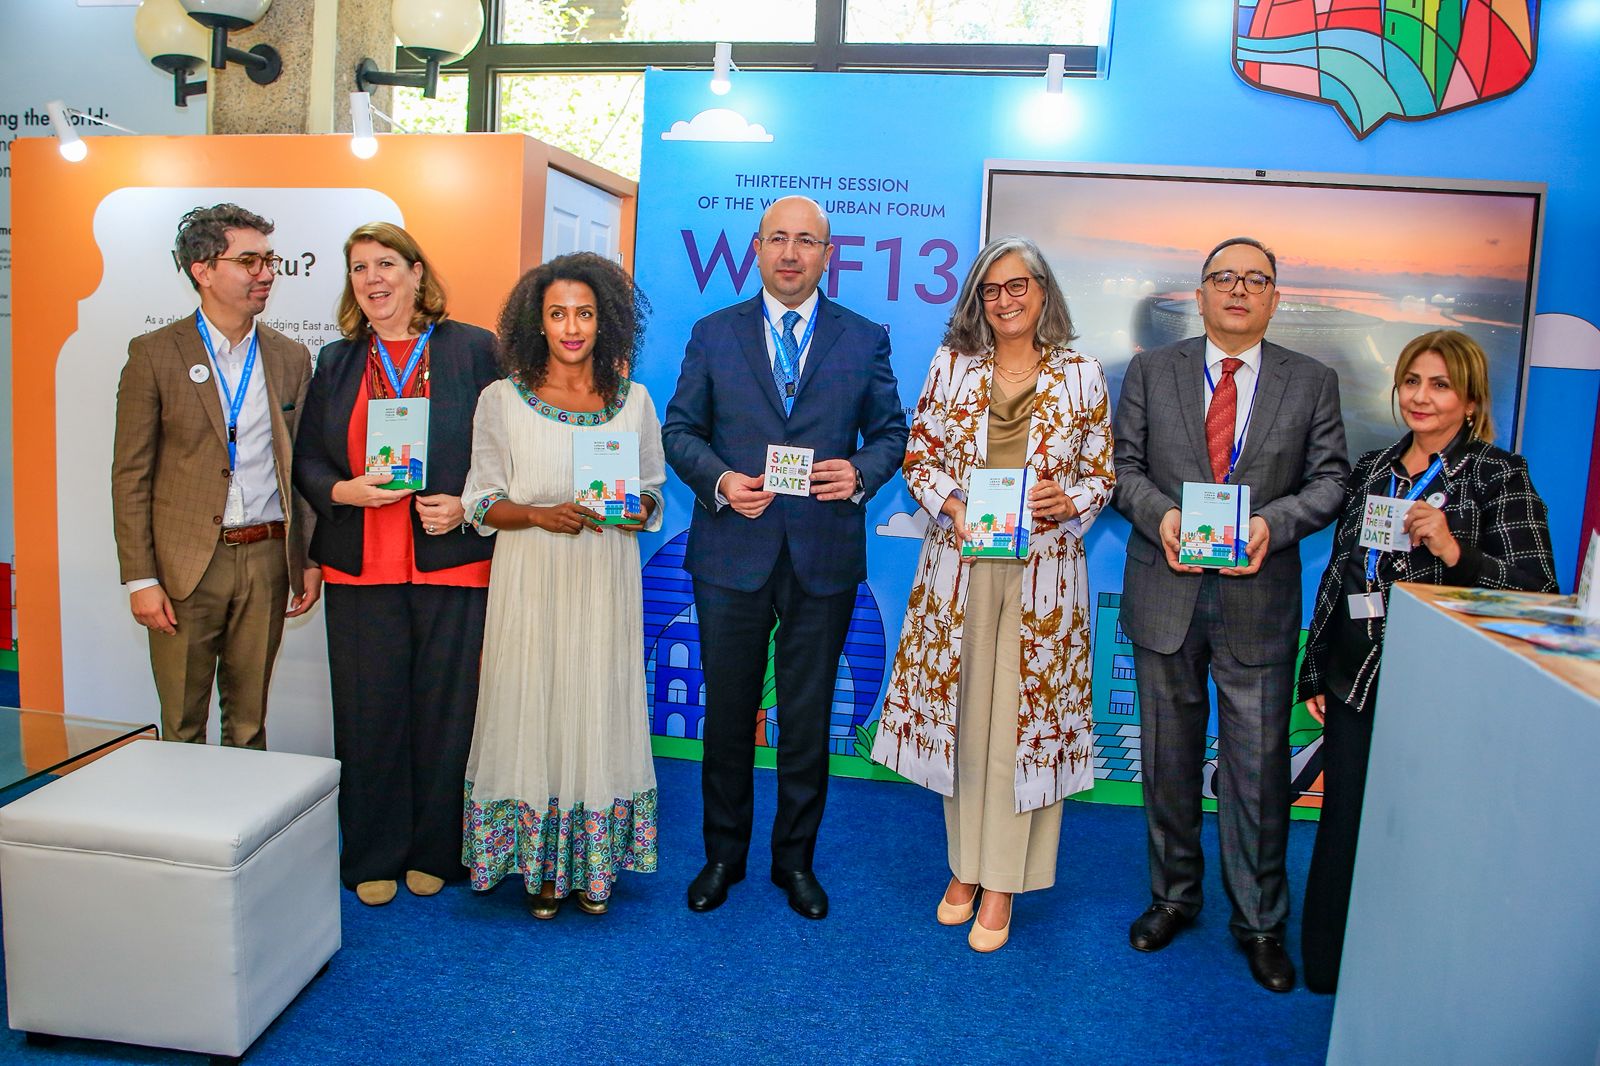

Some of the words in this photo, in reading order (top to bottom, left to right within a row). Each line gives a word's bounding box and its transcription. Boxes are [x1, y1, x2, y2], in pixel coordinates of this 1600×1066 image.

[24, 107, 50, 126] the
[735, 174, 832, 190] THIRTEENTH
[838, 177, 909, 193] SESSION
[698, 196, 719, 209] OF
[725, 197, 754, 210] THE
[826, 200, 881, 215] URBAN
[887, 203, 946, 218] FORUM
[680, 228, 959, 305] WF13
[145, 315, 156, 324] As
[303, 320, 321, 331] East
[307, 336, 325, 346] rich
[771, 451, 810, 467] SAVE
[770, 465, 788, 475] THE
[769, 474, 807, 491] DATE
[1368, 502, 1393, 518] SAVE
[1366, 517, 1378, 527] THE
[1364, 530, 1390, 545] DATE
